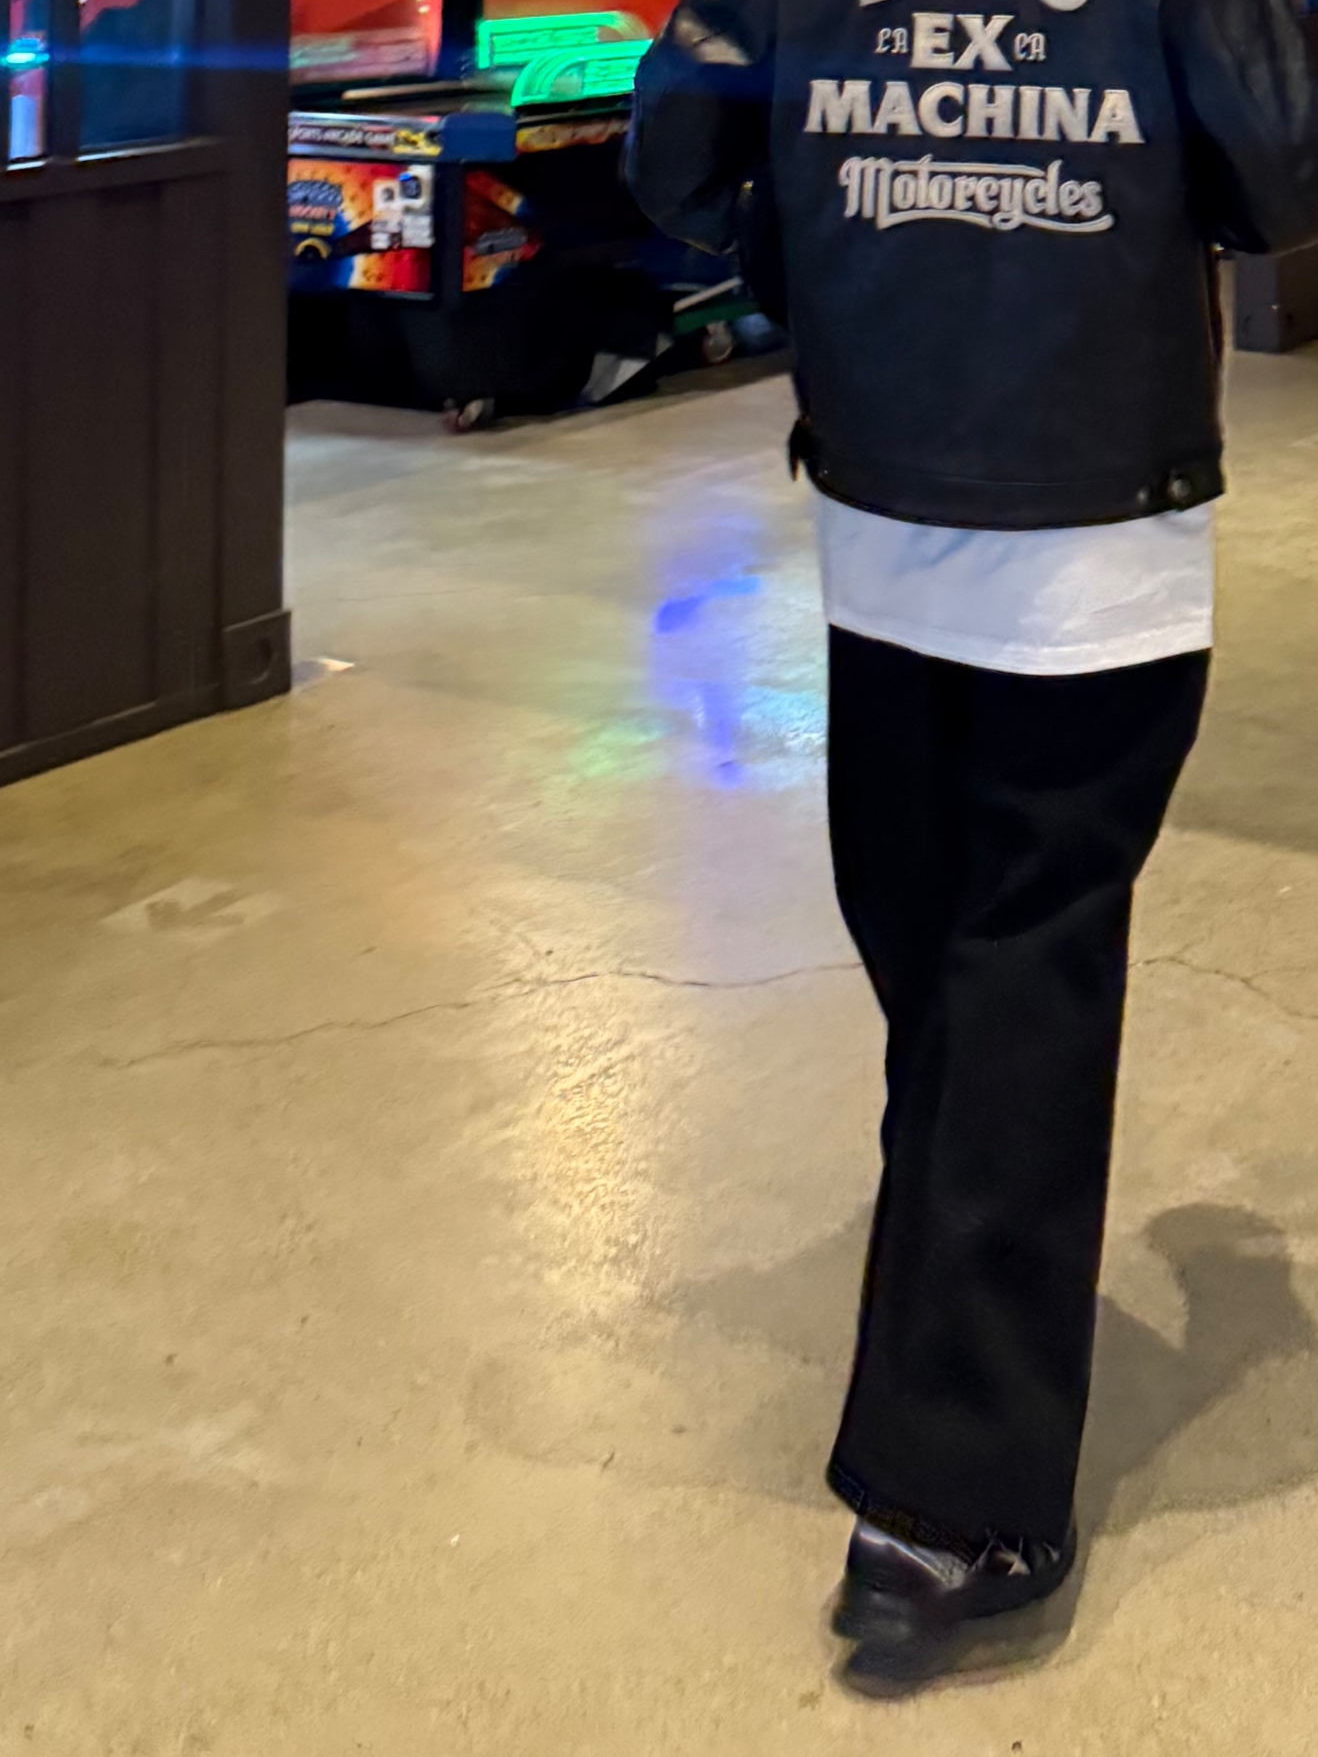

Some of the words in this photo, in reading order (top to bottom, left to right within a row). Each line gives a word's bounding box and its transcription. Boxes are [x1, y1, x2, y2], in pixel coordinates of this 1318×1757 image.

[909, 12, 1016, 71] EX
[803, 79, 1146, 144] MACHINA
[838, 154, 1116, 233] Motorcycles
